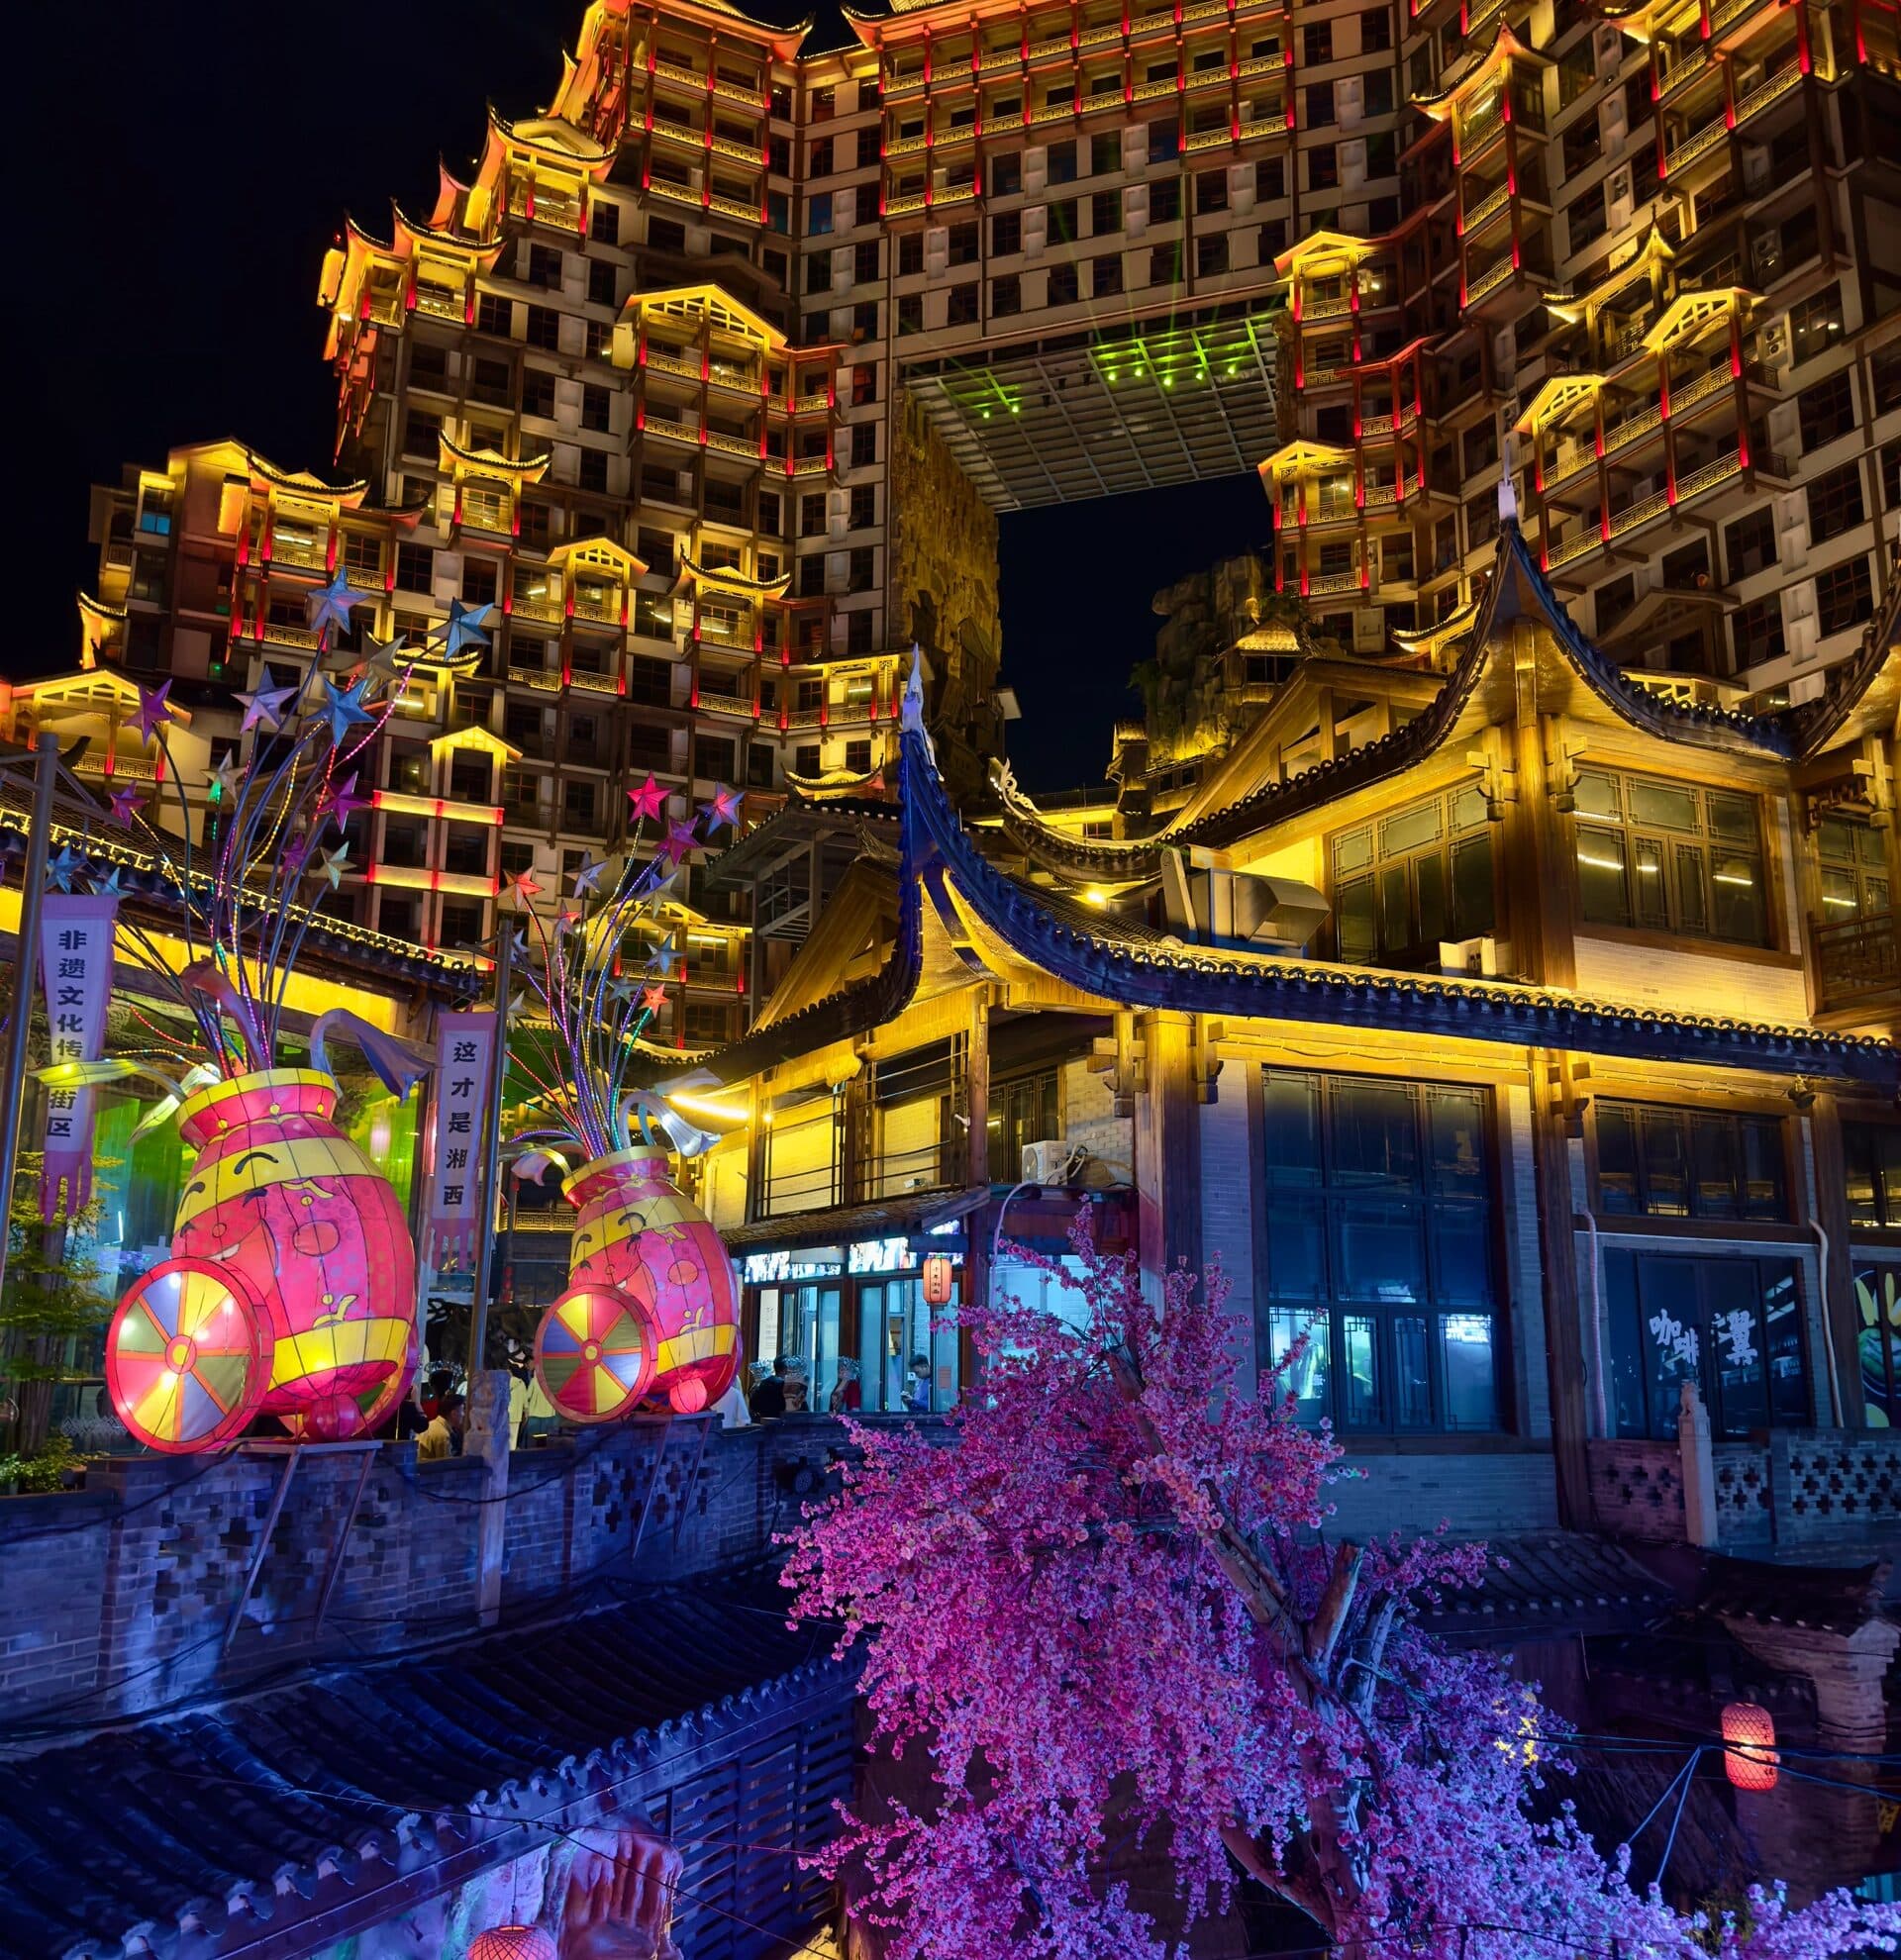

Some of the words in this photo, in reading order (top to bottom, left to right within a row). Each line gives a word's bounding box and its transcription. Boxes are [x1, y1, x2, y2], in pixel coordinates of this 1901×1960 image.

[47, 930, 87, 1137] 非遗文化传街区
[444, 1042, 477, 1206] 这才是湘西
